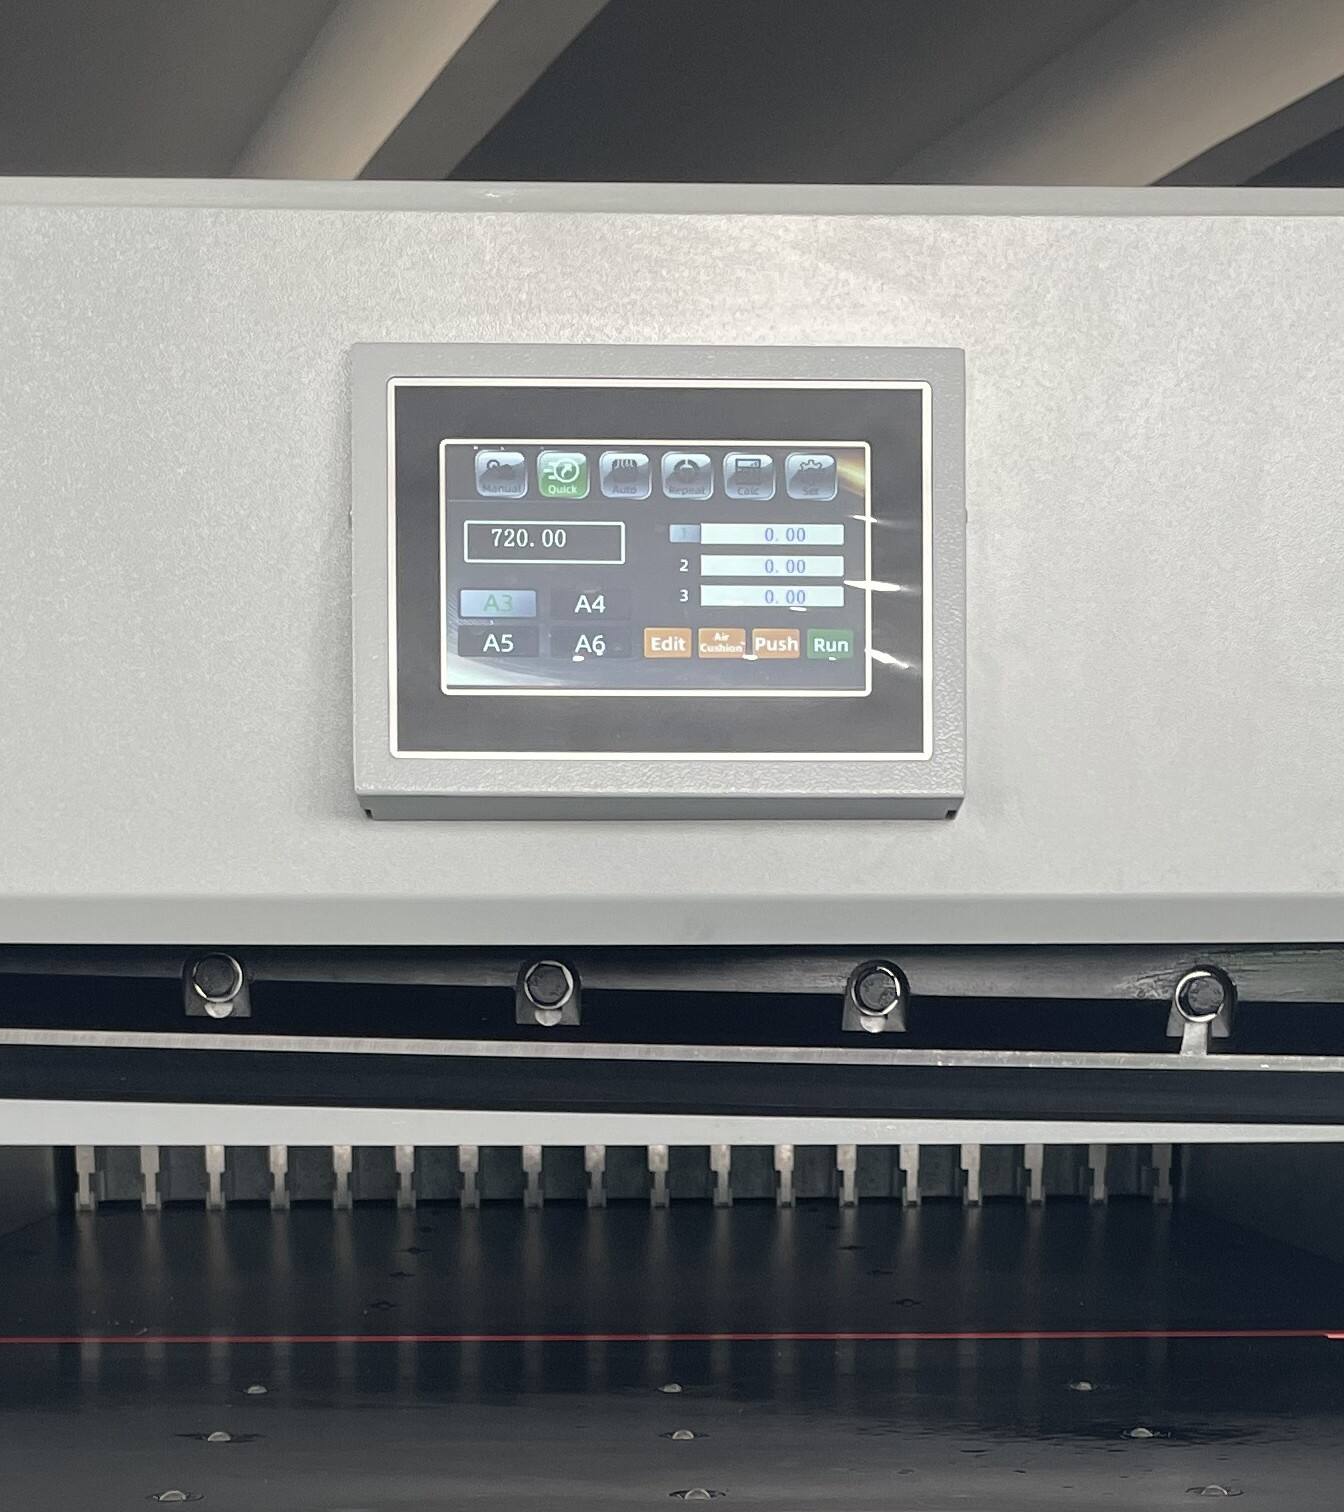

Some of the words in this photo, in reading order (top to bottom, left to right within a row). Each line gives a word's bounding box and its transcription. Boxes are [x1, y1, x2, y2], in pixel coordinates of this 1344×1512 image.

[548, 485, 577, 495] Quick
[612, 485, 638, 494] Auto
[737, 487, 760, 495] Calc
[491, 528, 567, 548] 720.00
[764, 527, 806, 542] 0.00
[679, 559, 689, 572] 2
[764, 559, 806, 574] 0.00
[483, 593, 513, 612] A3
[679, 589, 689, 602] 3
[764, 589, 806, 604] 0.00
[574, 595, 606, 613] A4
[482, 633, 514, 652] A5
[574, 634, 606, 654] A6
[650, 636, 686, 652] Edit
[714, 632, 730, 641] Air
[699, 643, 744, 653] Cushion
[755, 637, 799, 652] Push
[814, 638, 849, 653] Run
